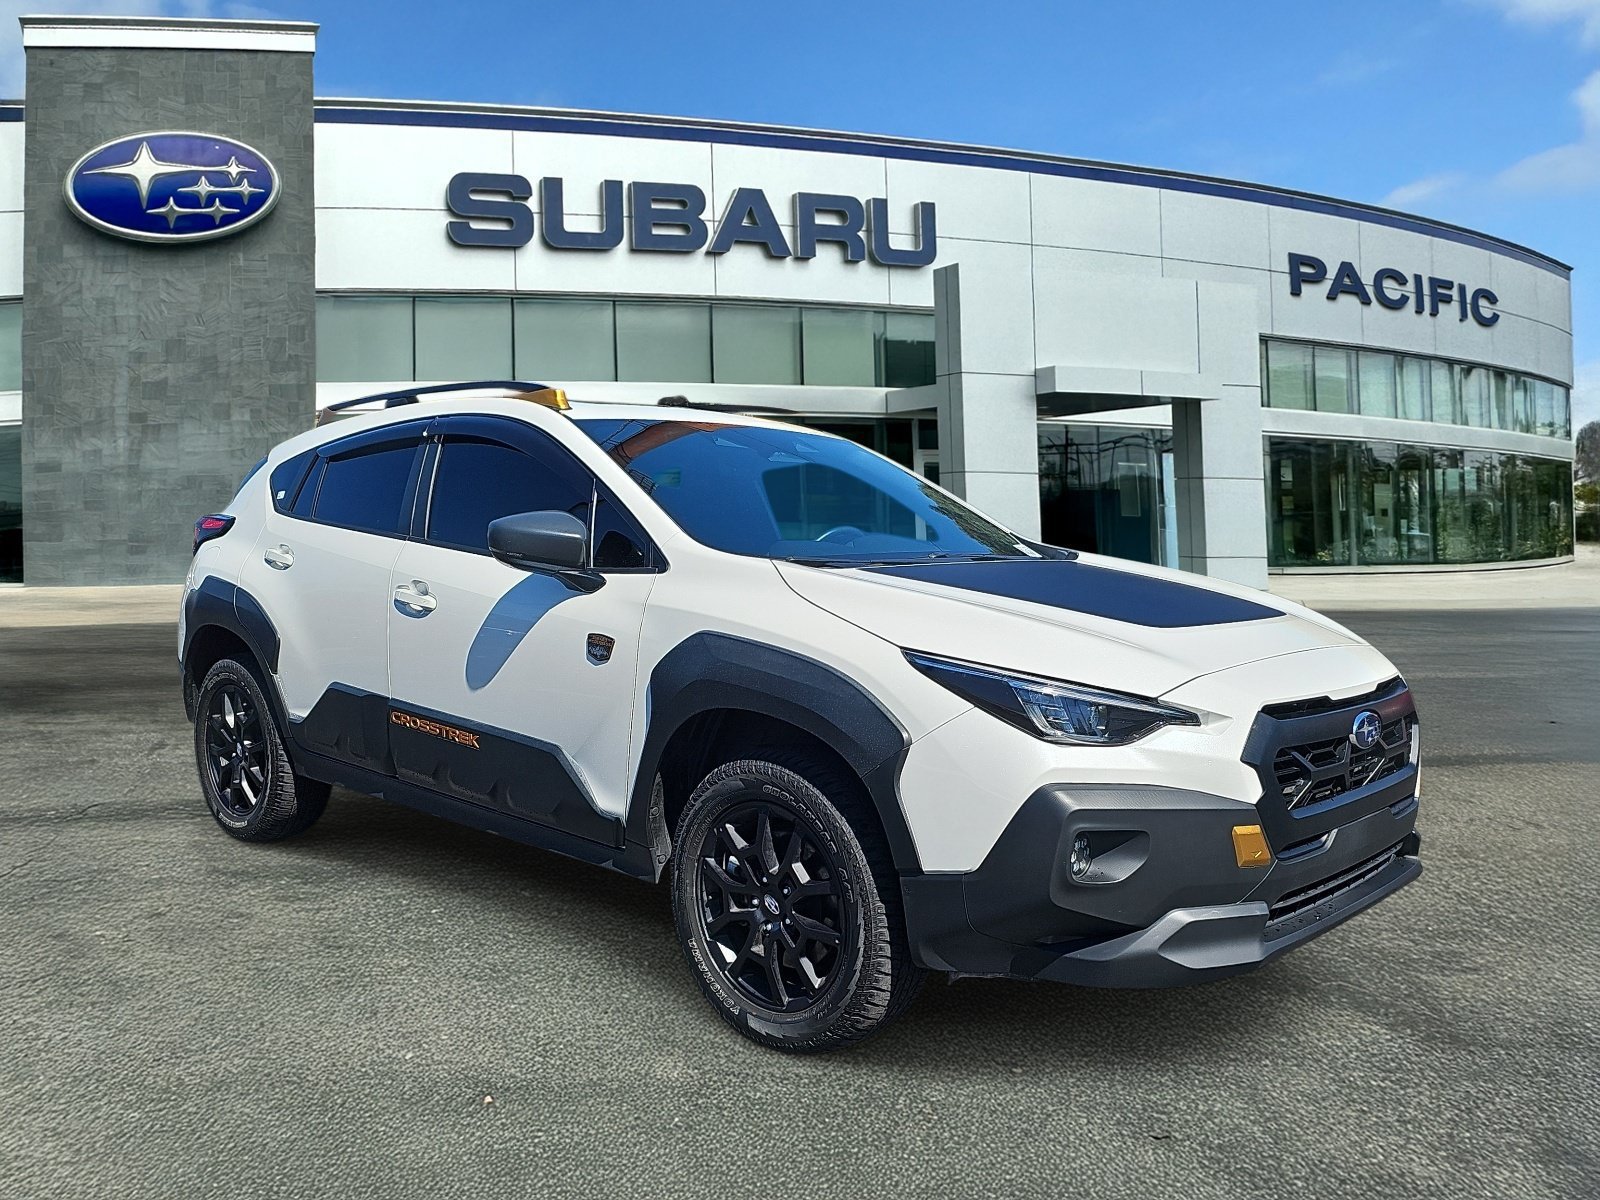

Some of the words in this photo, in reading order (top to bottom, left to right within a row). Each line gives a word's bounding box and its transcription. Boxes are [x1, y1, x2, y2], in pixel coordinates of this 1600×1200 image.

[446, 172, 938, 267] SUBARU
[1288, 252, 1500, 327] PACIFIC
[391, 711, 480, 749] CROSSTREK
[687, 937, 741, 1015] YOKOHAMA
